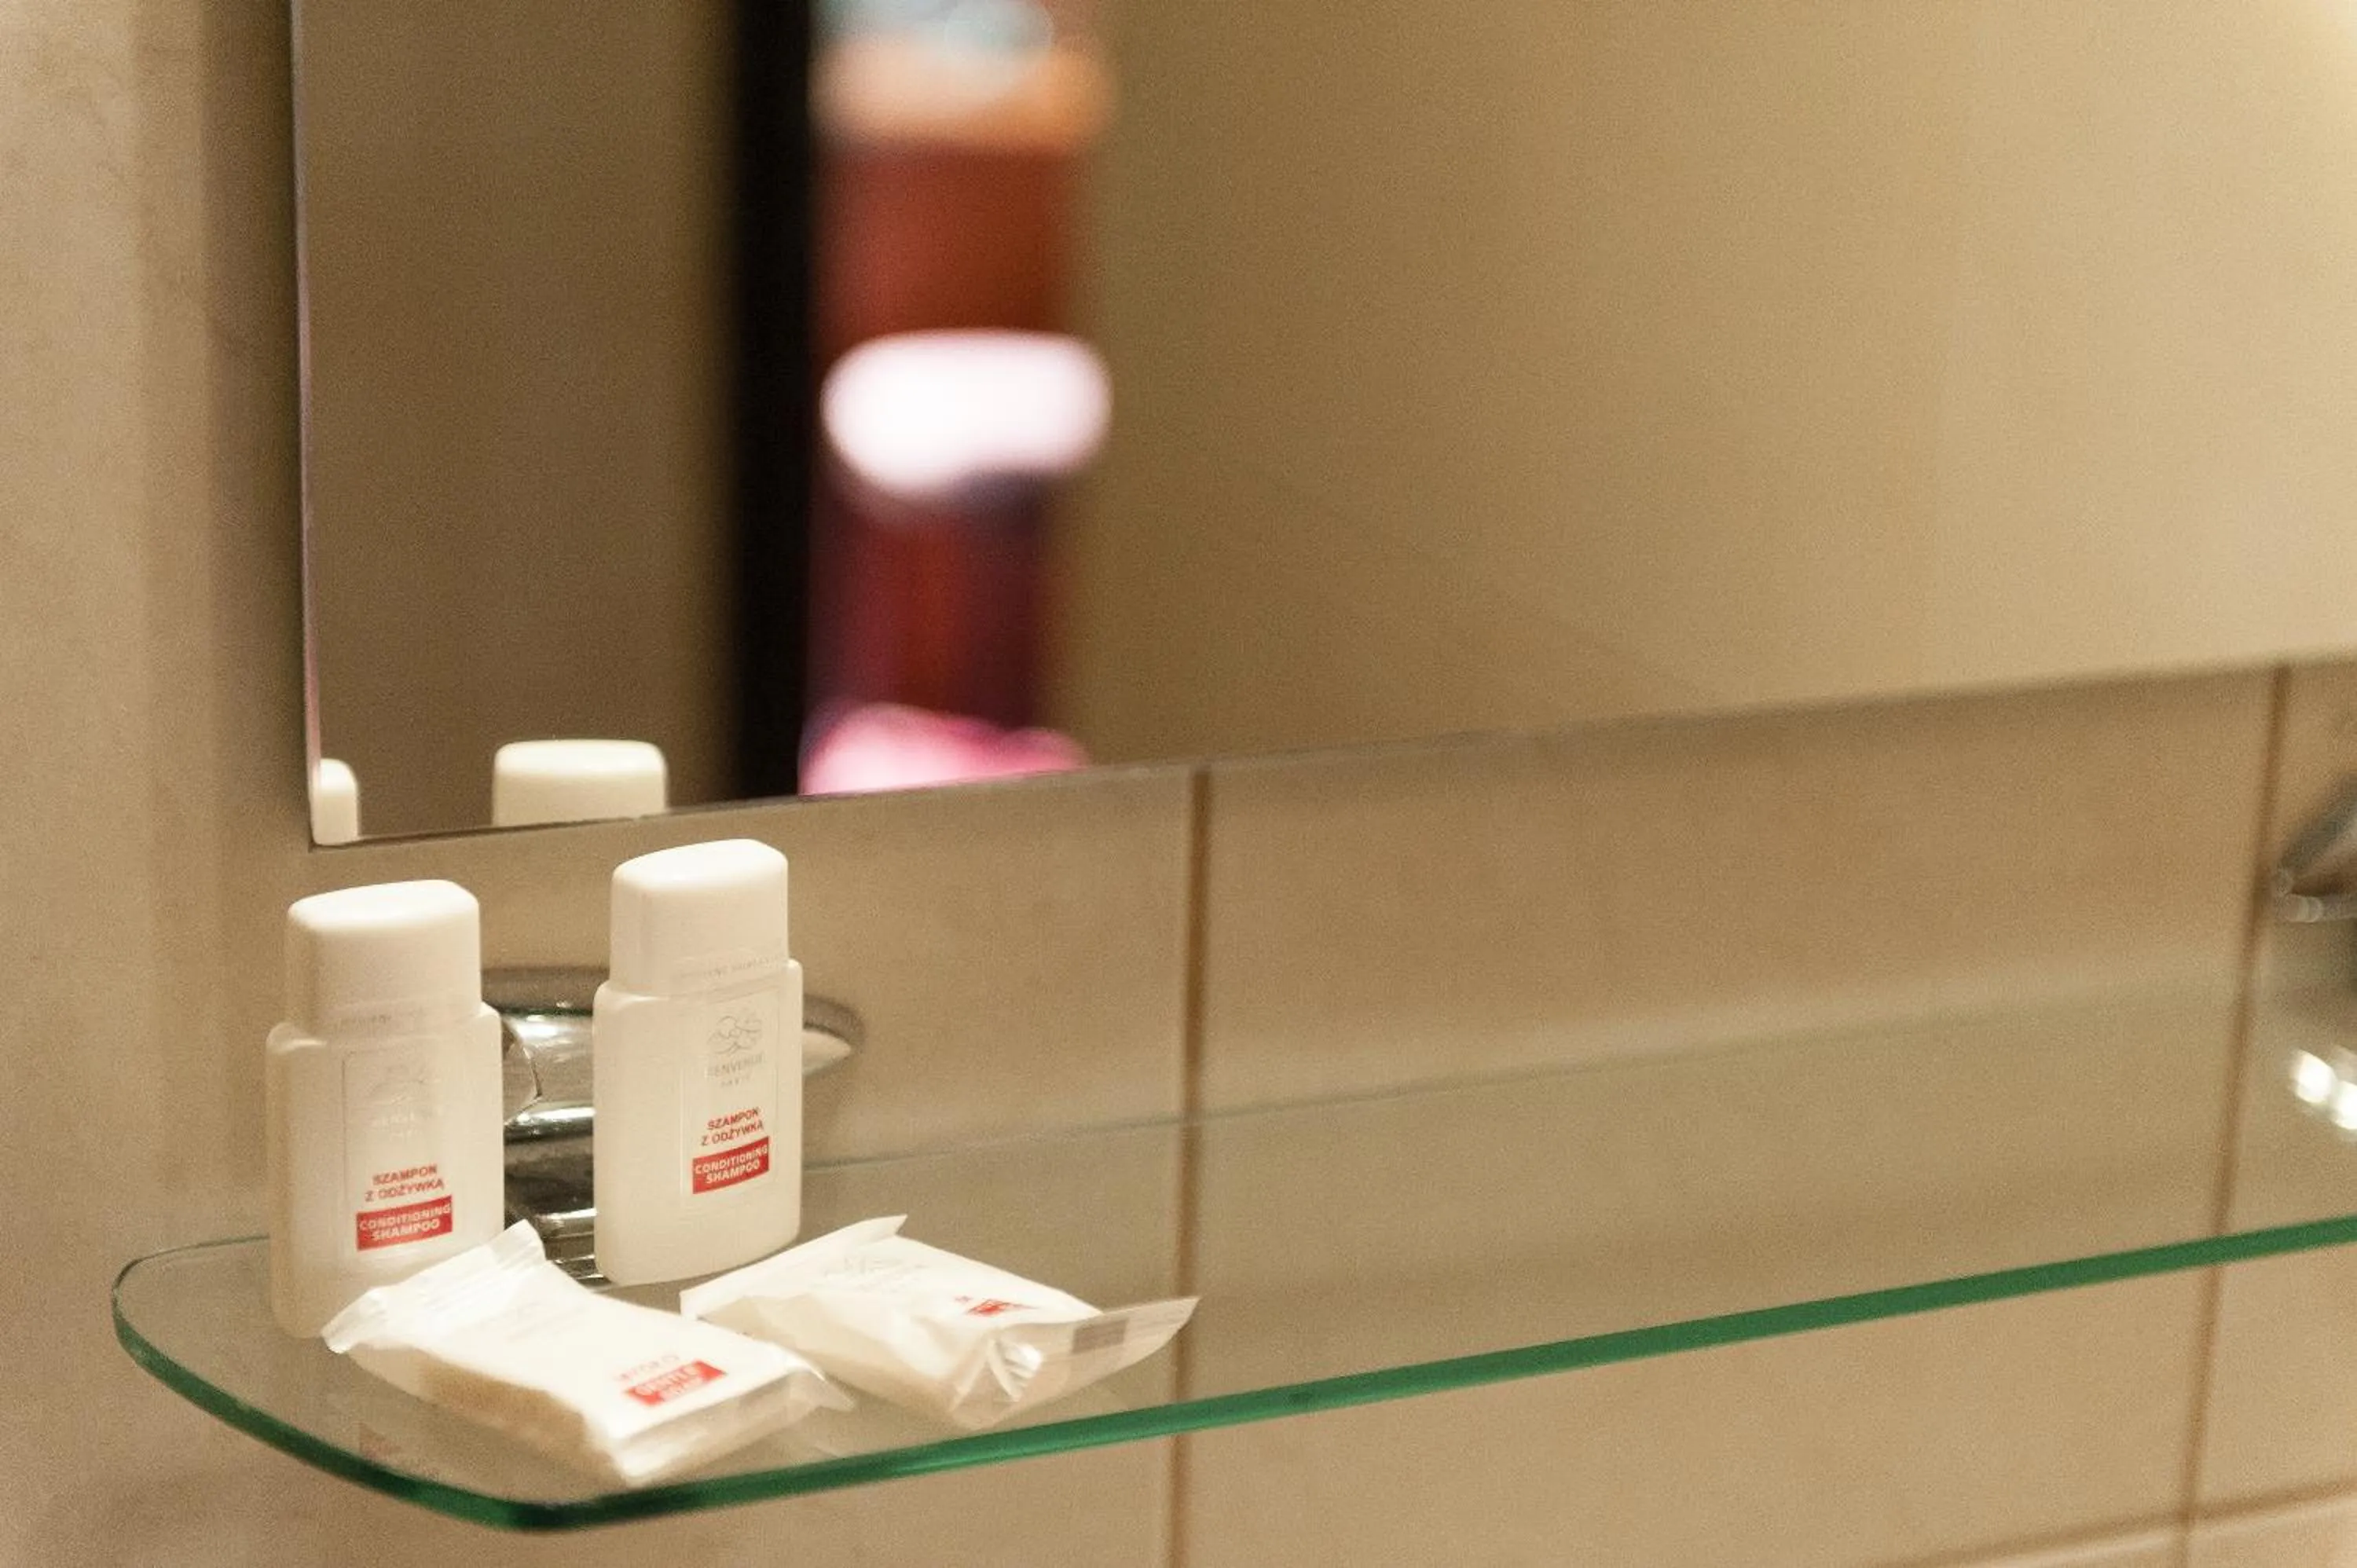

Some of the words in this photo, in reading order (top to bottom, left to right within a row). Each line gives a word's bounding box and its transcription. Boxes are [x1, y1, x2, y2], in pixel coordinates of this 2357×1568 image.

[707, 1106, 760, 1130] SZAMPON
[695, 1147, 768, 1174] CONDITIONING
[706, 1159, 760, 1184] SHAMPOO
[372, 1164, 438, 1185] SZAMPON
[365, 1190, 374, 1202] Z
[359, 1203, 451, 1231] CONDITIONING
[371, 1218, 440, 1241] SHAMPOO
